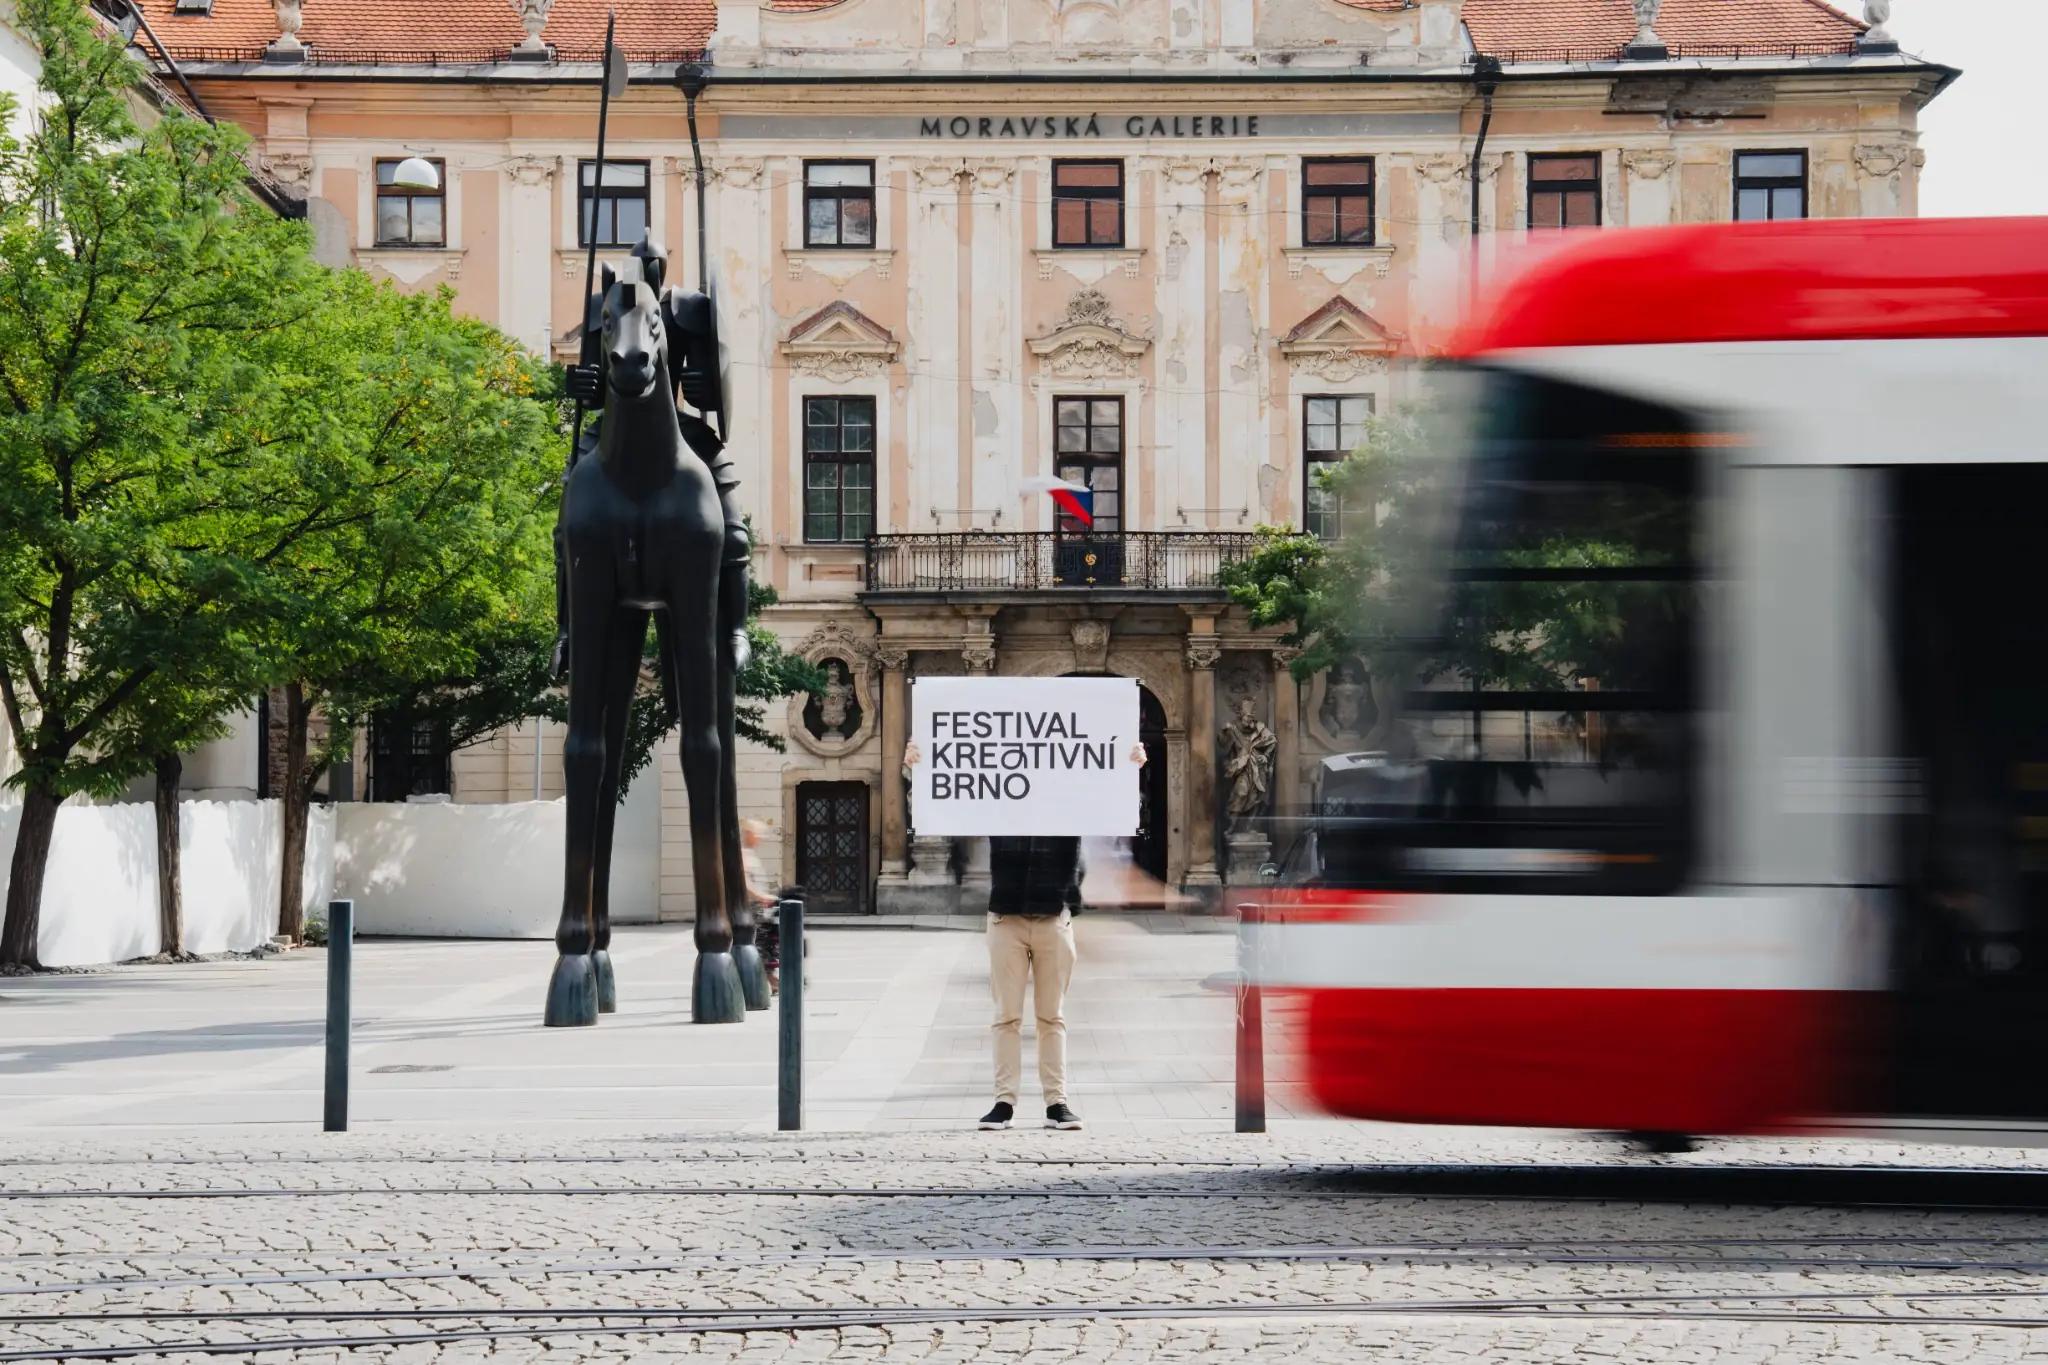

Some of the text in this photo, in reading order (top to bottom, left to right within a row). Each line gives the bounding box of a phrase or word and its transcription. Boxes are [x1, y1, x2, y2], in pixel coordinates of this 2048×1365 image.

[920, 112, 1259, 138] MORAVSKÁ GALERIE
[932, 711, 1088, 739] FESTIVAL
[931, 773, 1031, 800] BRNO
